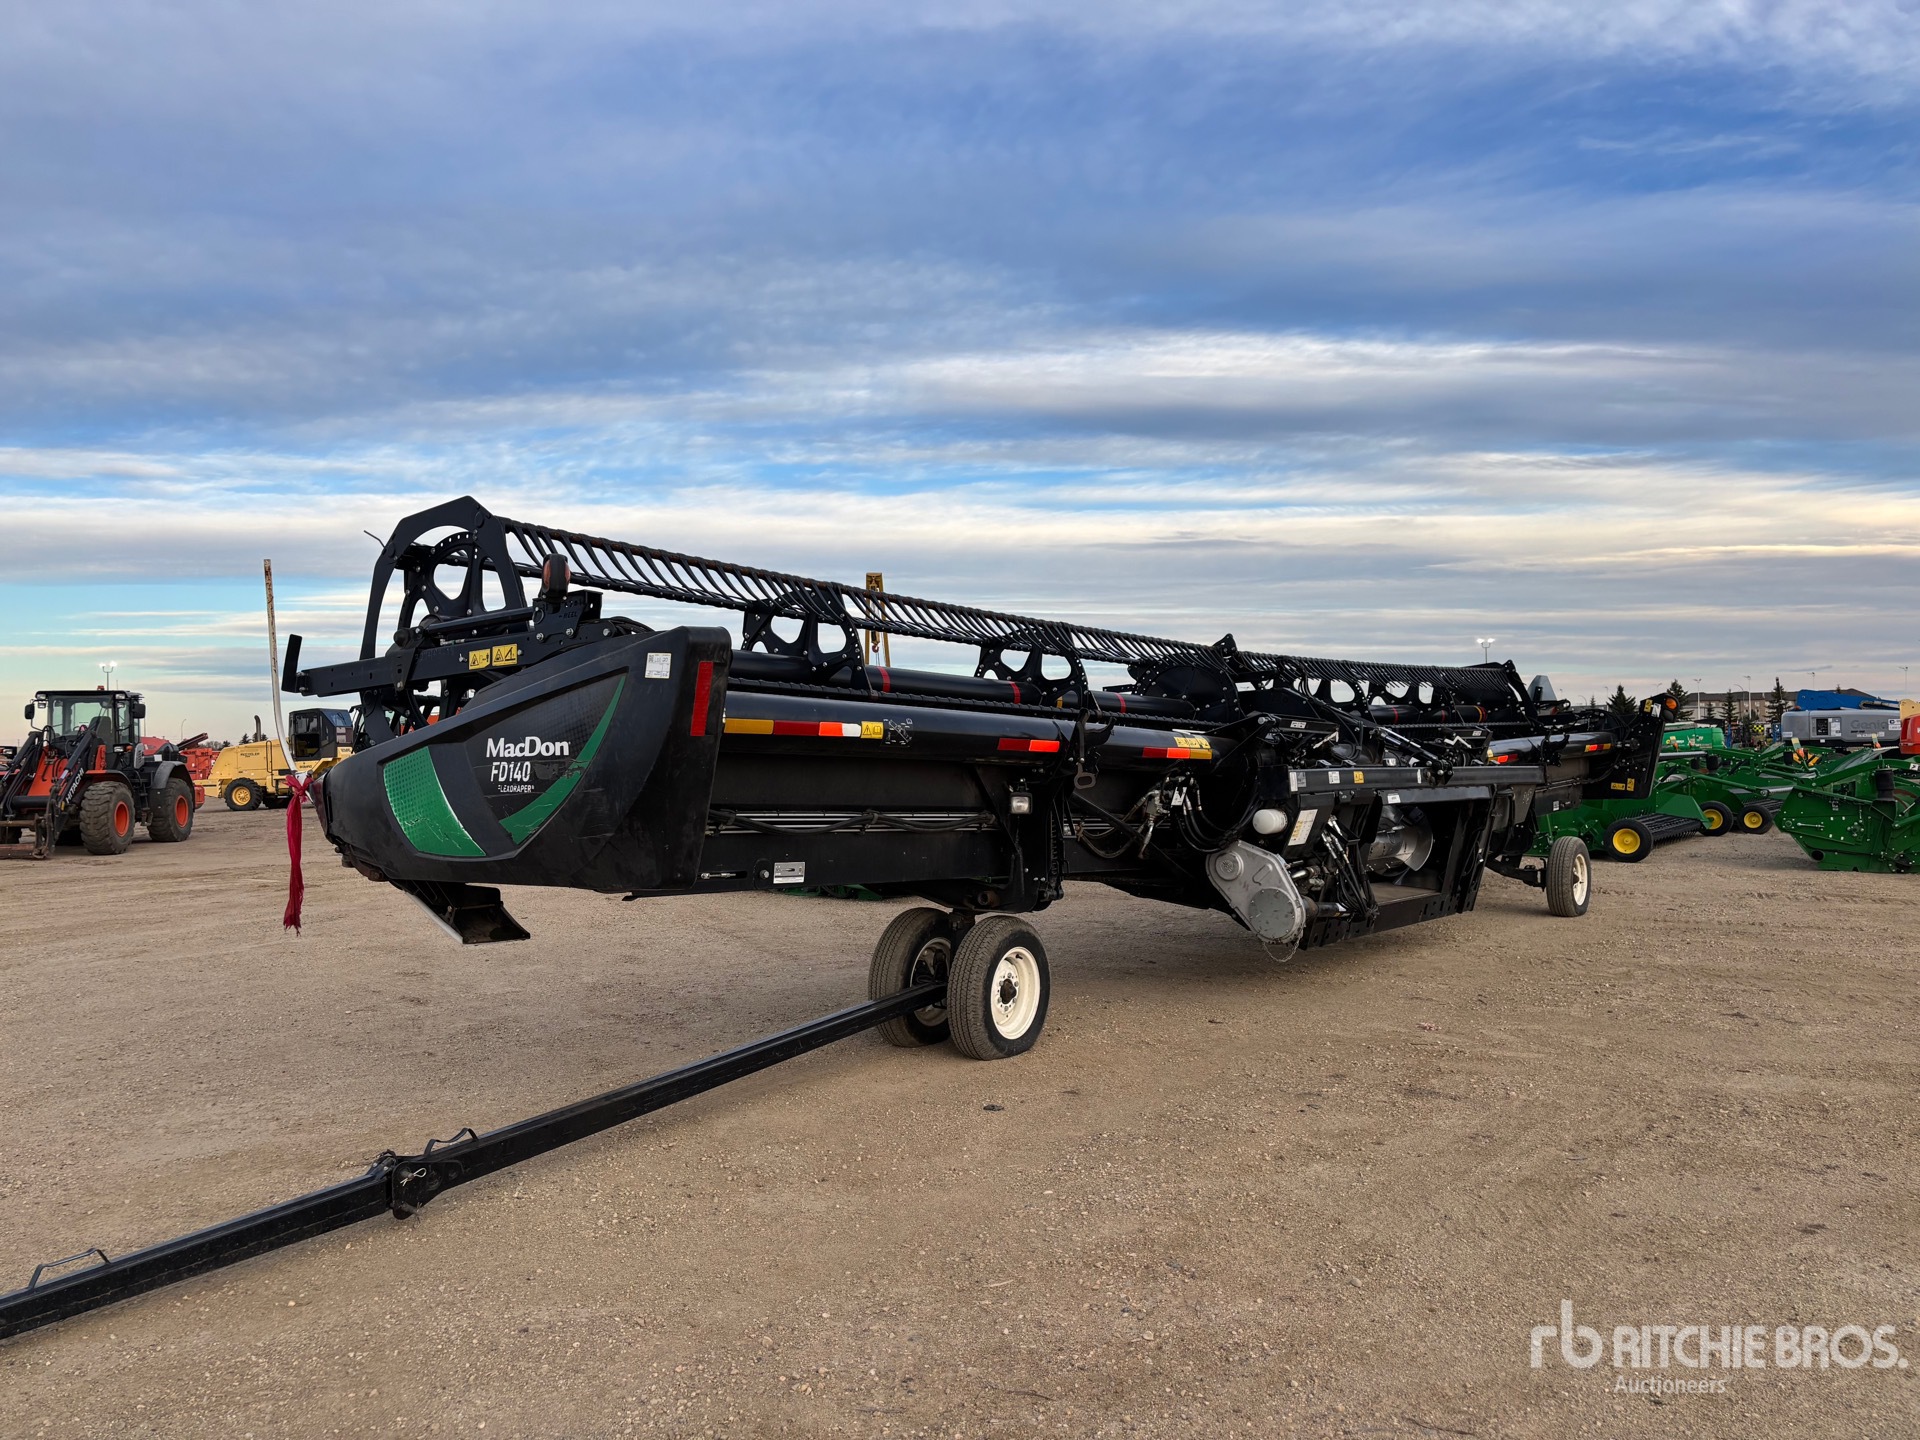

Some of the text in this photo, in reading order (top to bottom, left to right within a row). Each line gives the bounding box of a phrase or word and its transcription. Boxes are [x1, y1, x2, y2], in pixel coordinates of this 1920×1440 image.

[486, 736, 570, 758] MacDon
[490, 761, 531, 782] FD140
[65, 767, 85, 804] HITACHI
